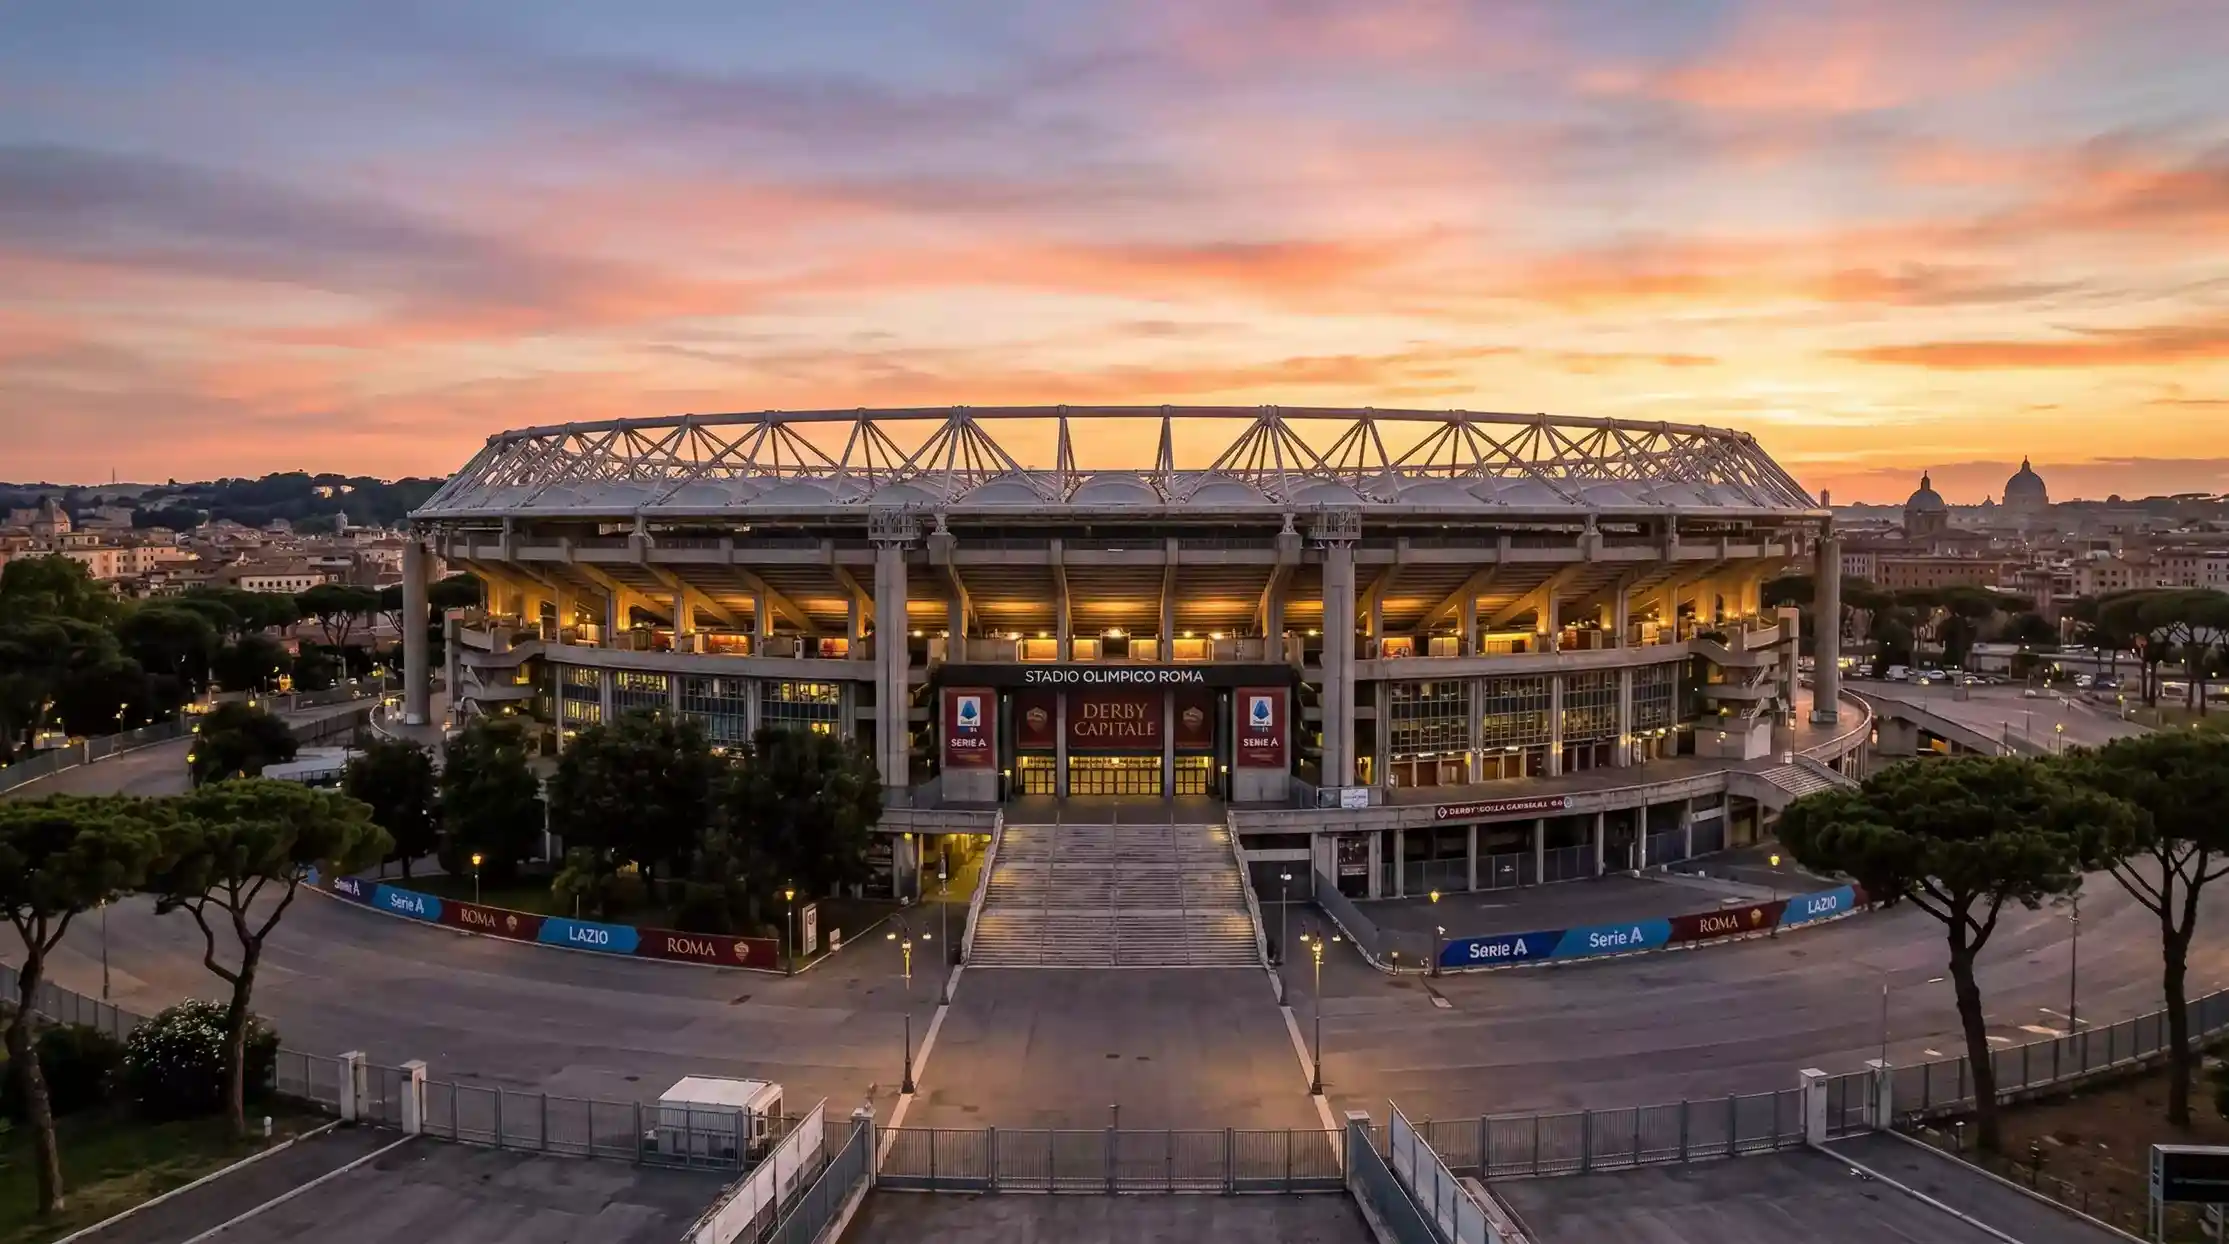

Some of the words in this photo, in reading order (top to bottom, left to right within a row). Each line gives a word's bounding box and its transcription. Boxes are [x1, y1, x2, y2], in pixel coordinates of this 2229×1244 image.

[1025, 670, 1079, 683] STADIO
[1083, 670, 1156, 683] OLIMPICO
[1159, 670, 1204, 683] ROMA
[1083, 703, 1148, 719] DERBY
[1074, 722, 1156, 737] CAPITALE
[951, 738, 977, 747] SERIE
[978, 738, 987, 747] A
[1270, 737, 1279, 747] A
[390, 893, 414, 912] Serie
[415, 897, 425, 914] A
[1807, 895, 1837, 914] LAZIO
[460, 908, 496, 928] ROMA
[1700, 915, 1739, 933] ROMA
[569, 926, 608, 945] LAZIO
[1589, 930, 1627, 948] Serie
[1630, 926, 1644, 944] A
[667, 937, 716, 957] ROMA
[1513, 938, 1528, 956] A
